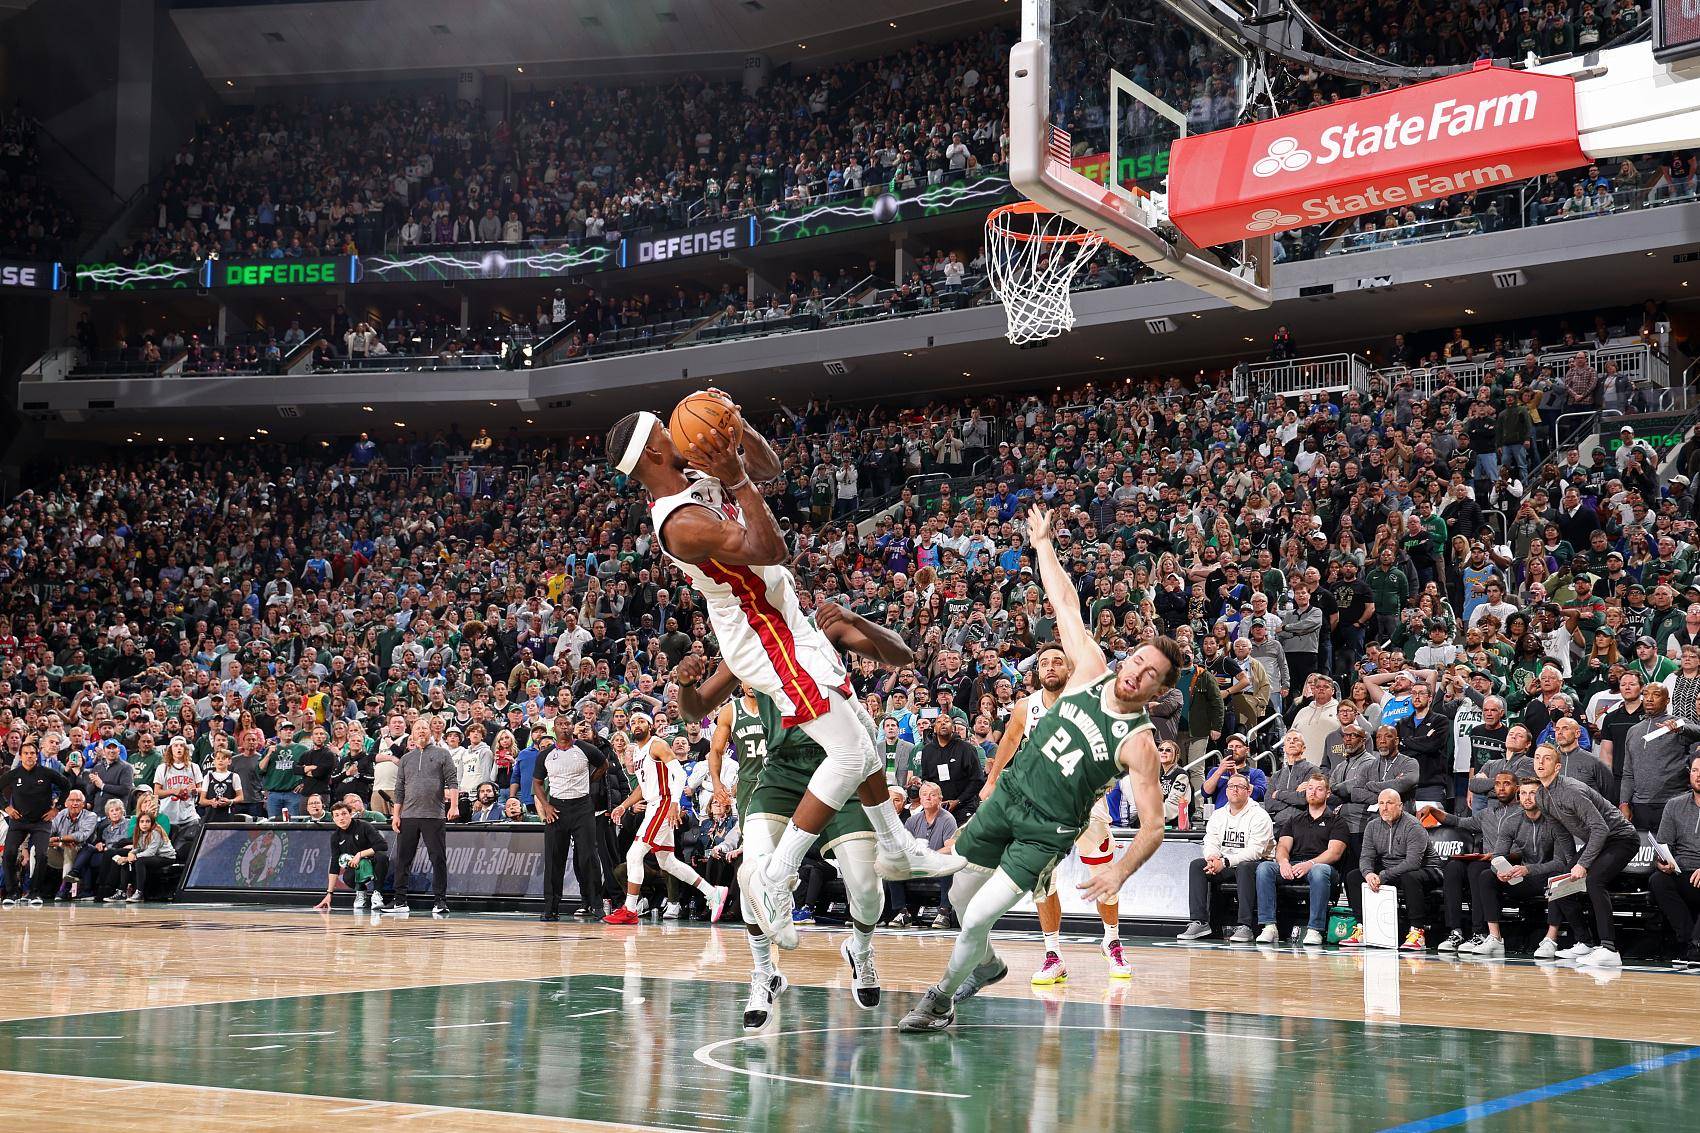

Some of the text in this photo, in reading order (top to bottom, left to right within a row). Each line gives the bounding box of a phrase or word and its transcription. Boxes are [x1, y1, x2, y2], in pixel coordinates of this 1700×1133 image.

[639, 228, 736, 262] DEFENSE
[2, 267, 36, 287] SE
[227, 262, 336, 286] DEFENSE
[1497, 273, 1518, 288] 117
[1149, 320, 1168, 334] 117
[825, 363, 844, 375] 116
[280, 406, 298, 418] 115
[949, 602, 970, 612] BUCKS
[1457, 711, 1483, 723] BUCKS
[745, 740, 767, 758] 34
[1041, 726, 1084, 777] 24
[167, 775, 194, 785] BUCKS
[1174, 780, 1187, 793] 23
[299, 848, 320, 874] VS
